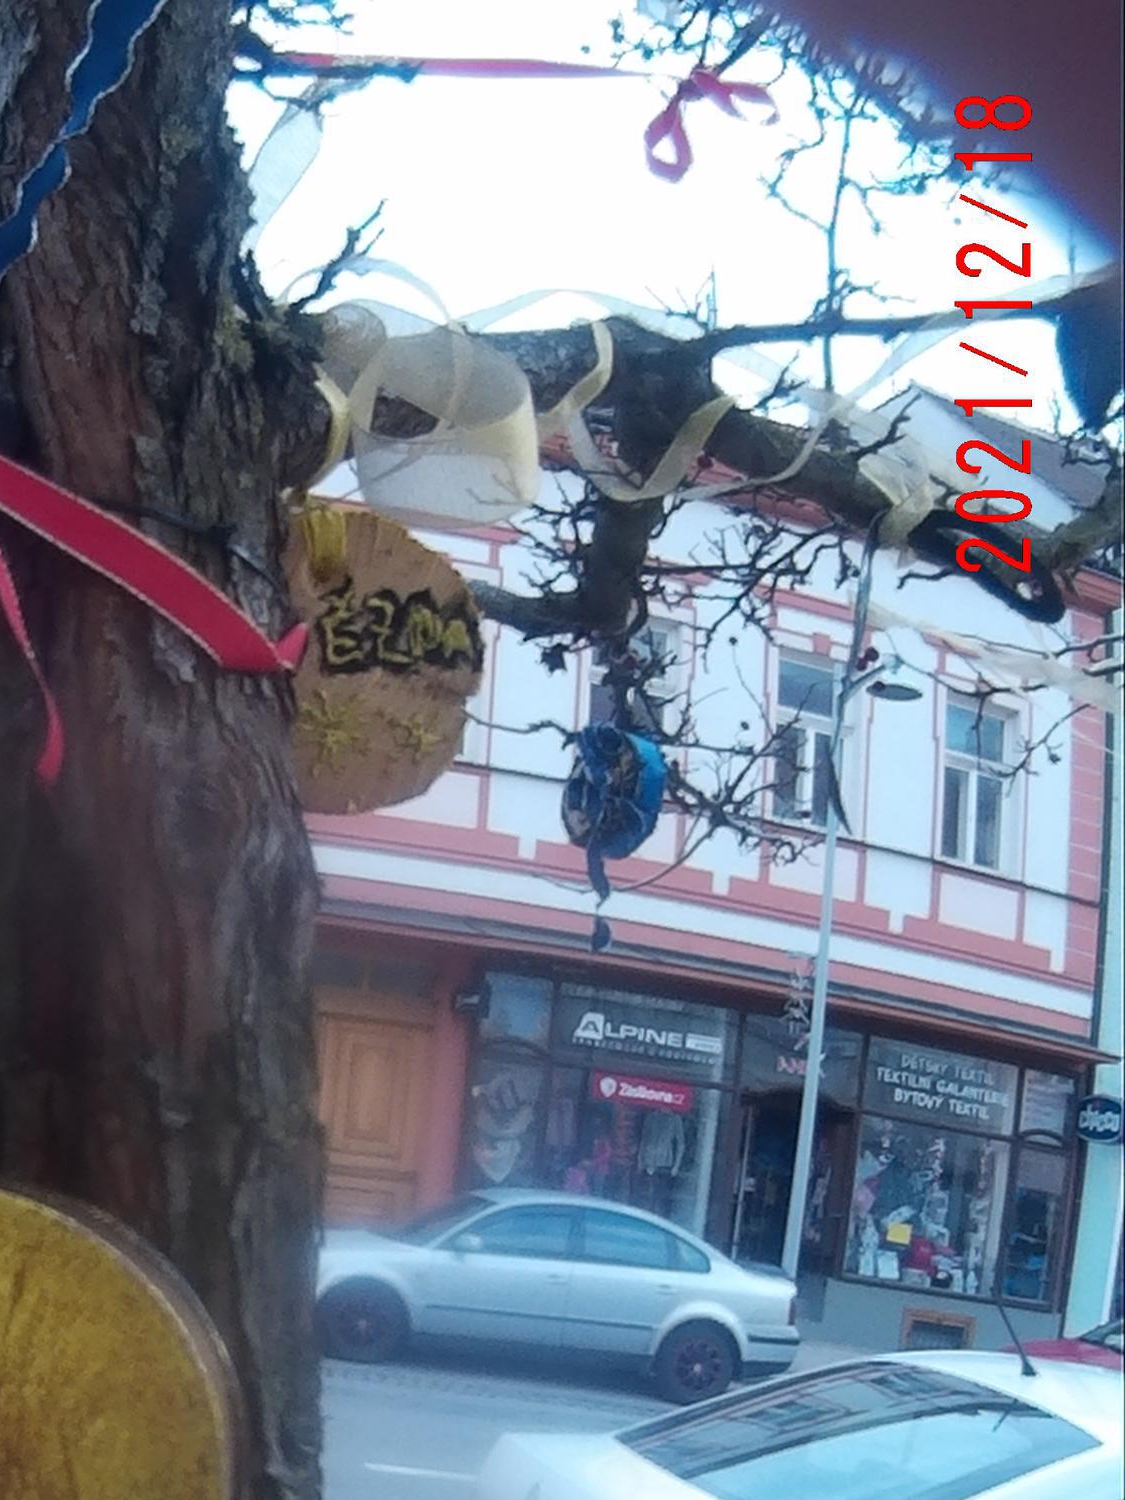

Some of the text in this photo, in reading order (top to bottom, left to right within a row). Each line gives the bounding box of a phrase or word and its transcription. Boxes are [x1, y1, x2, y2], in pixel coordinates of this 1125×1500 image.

[573, 1011, 683, 1048] ALPINE
[955, 1065, 994, 1086] TEXTIL
[894, 1087, 990, 1120] BYTOVÝ TEXTIL
